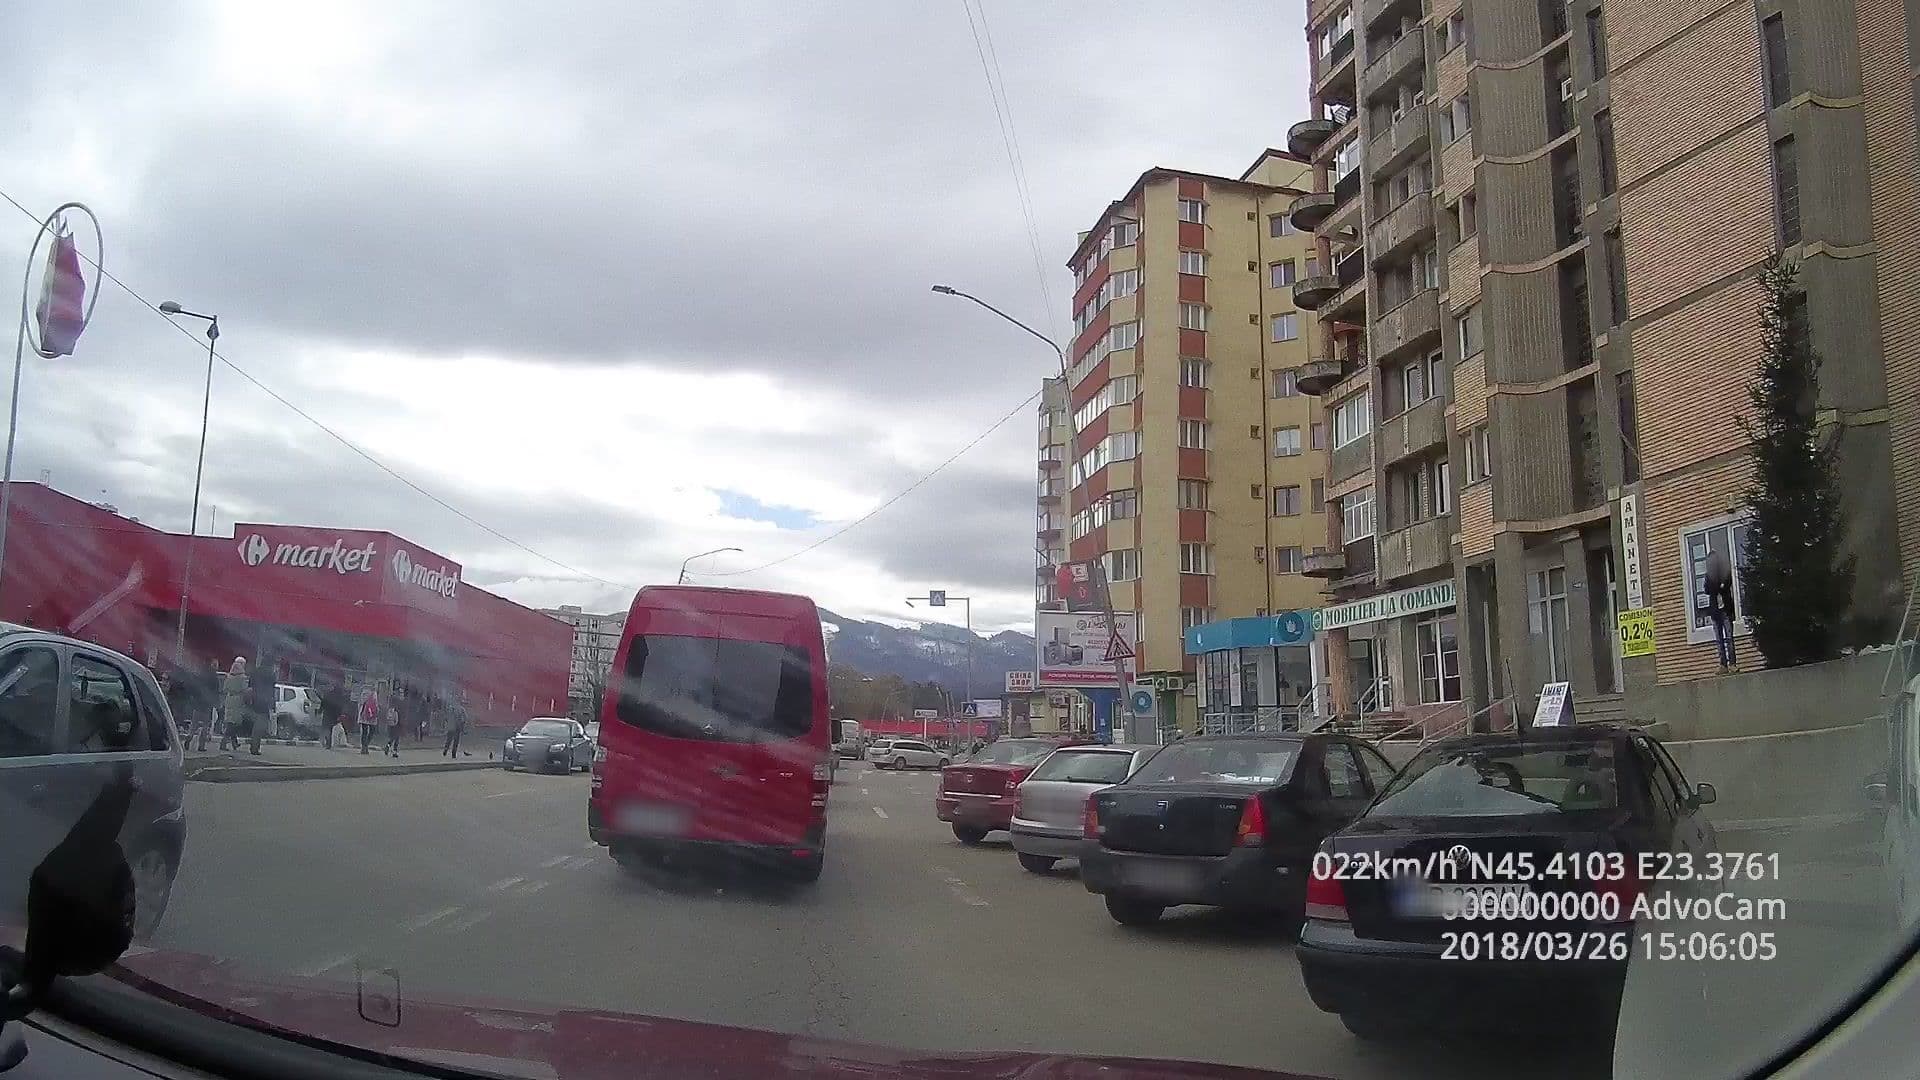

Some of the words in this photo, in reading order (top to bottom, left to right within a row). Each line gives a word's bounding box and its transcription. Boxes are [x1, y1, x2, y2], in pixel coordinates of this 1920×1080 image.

[272, 538, 377, 575] market
[1624, 501, 1638, 591] AMANET
[412, 565, 458, 597] market
[1325, 602, 1376, 627] MOBILIER
[1379, 597, 1397, 616] LA
[1620, 621, 1653, 641] 0.2%
